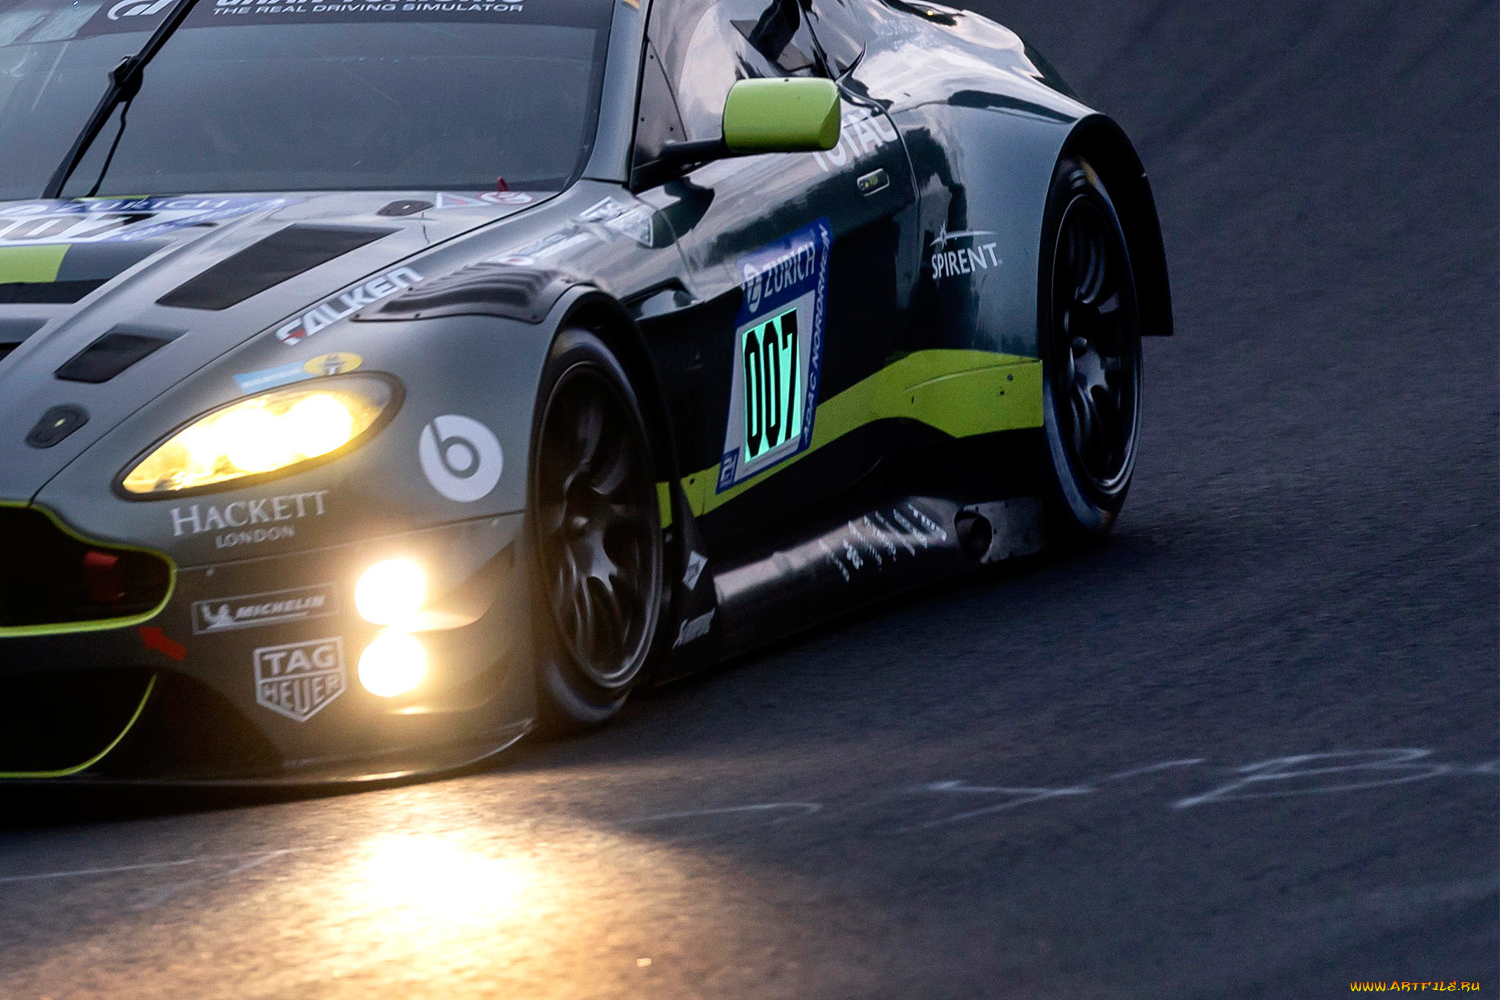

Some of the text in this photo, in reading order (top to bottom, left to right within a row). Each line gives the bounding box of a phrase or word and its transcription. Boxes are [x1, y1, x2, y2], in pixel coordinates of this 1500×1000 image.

[213, 3, 524, 16] THE REAL DRIVING SIMULATOR
[763, 241, 816, 299] ZURICH
[931, 242, 998, 279] SPIRENT
[744, 308, 798, 459] 007
[170, 490, 329, 537] HACKETT
[215, 525, 296, 549] LONDON
[234, 595, 325, 621] MICHELIN
[262, 644, 335, 676] TAG
[262, 675, 341, 714] HEUER
